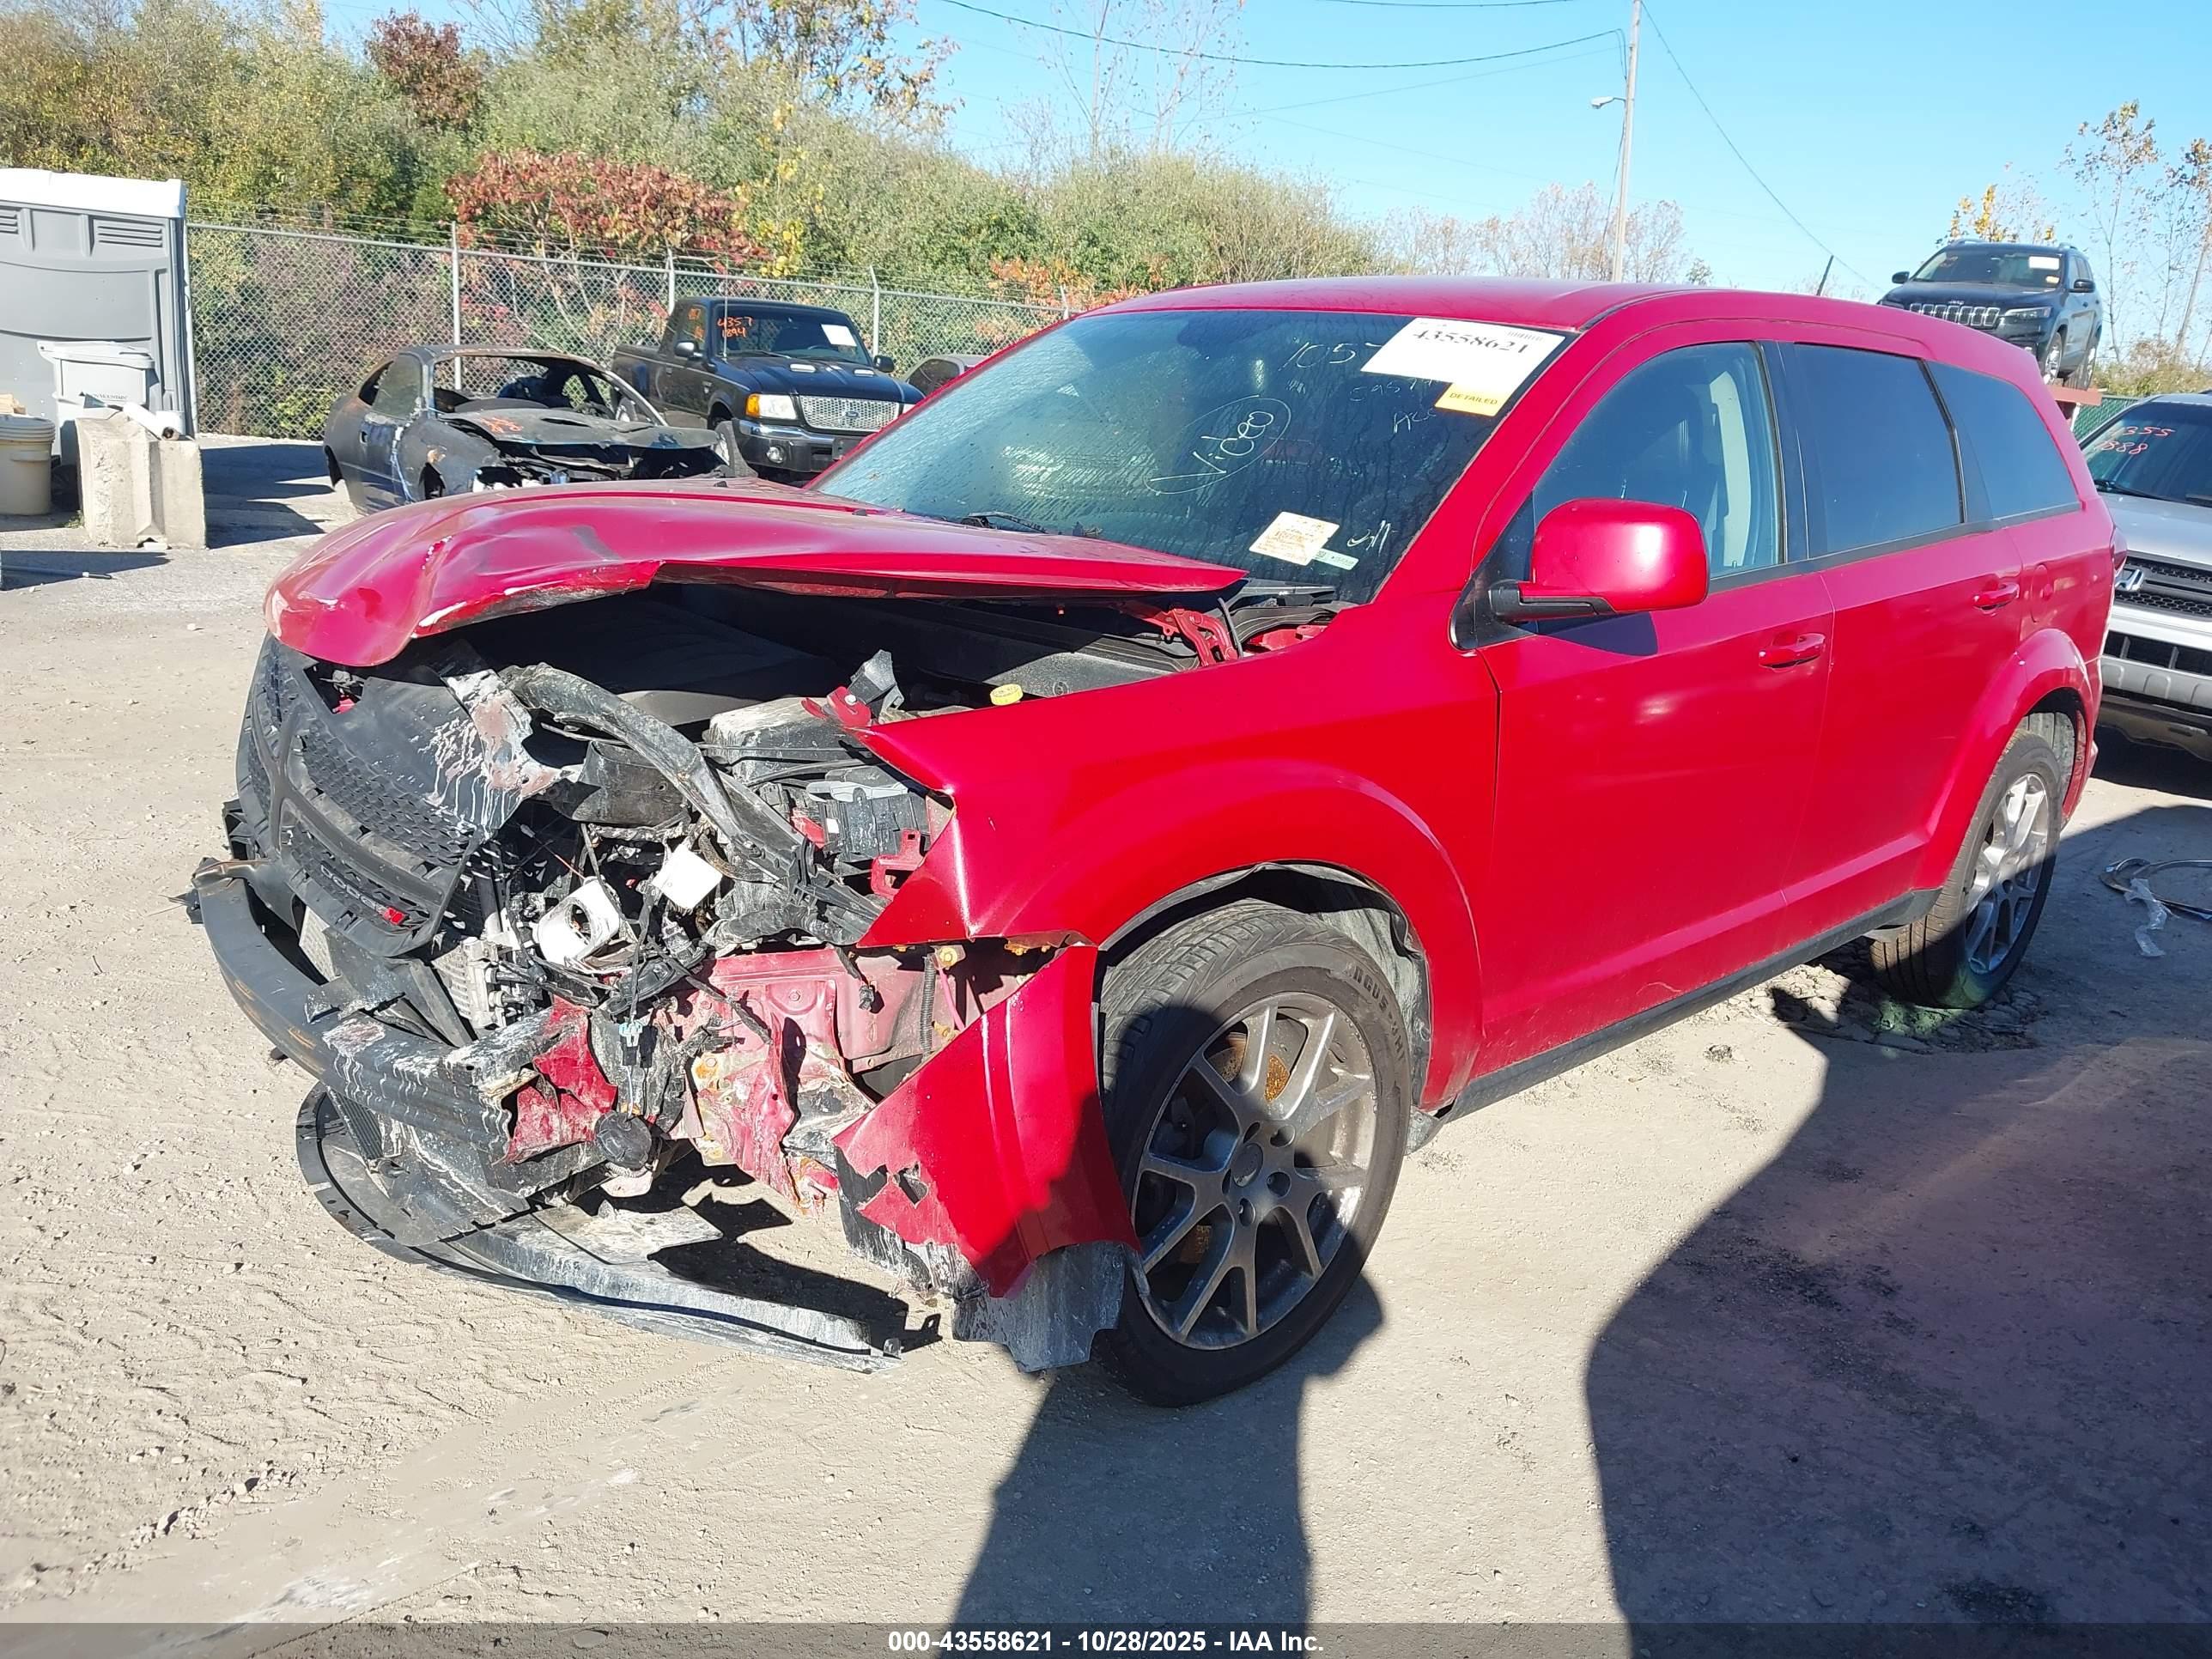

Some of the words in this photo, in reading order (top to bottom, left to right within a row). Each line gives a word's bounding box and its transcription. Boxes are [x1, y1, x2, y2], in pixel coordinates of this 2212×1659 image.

[716, 316, 754, 327] 4357
[722, 326, 747, 338] 1894
[1413, 329, 1529, 354] 43558621
[1448, 392, 1499, 406] DETAILED
